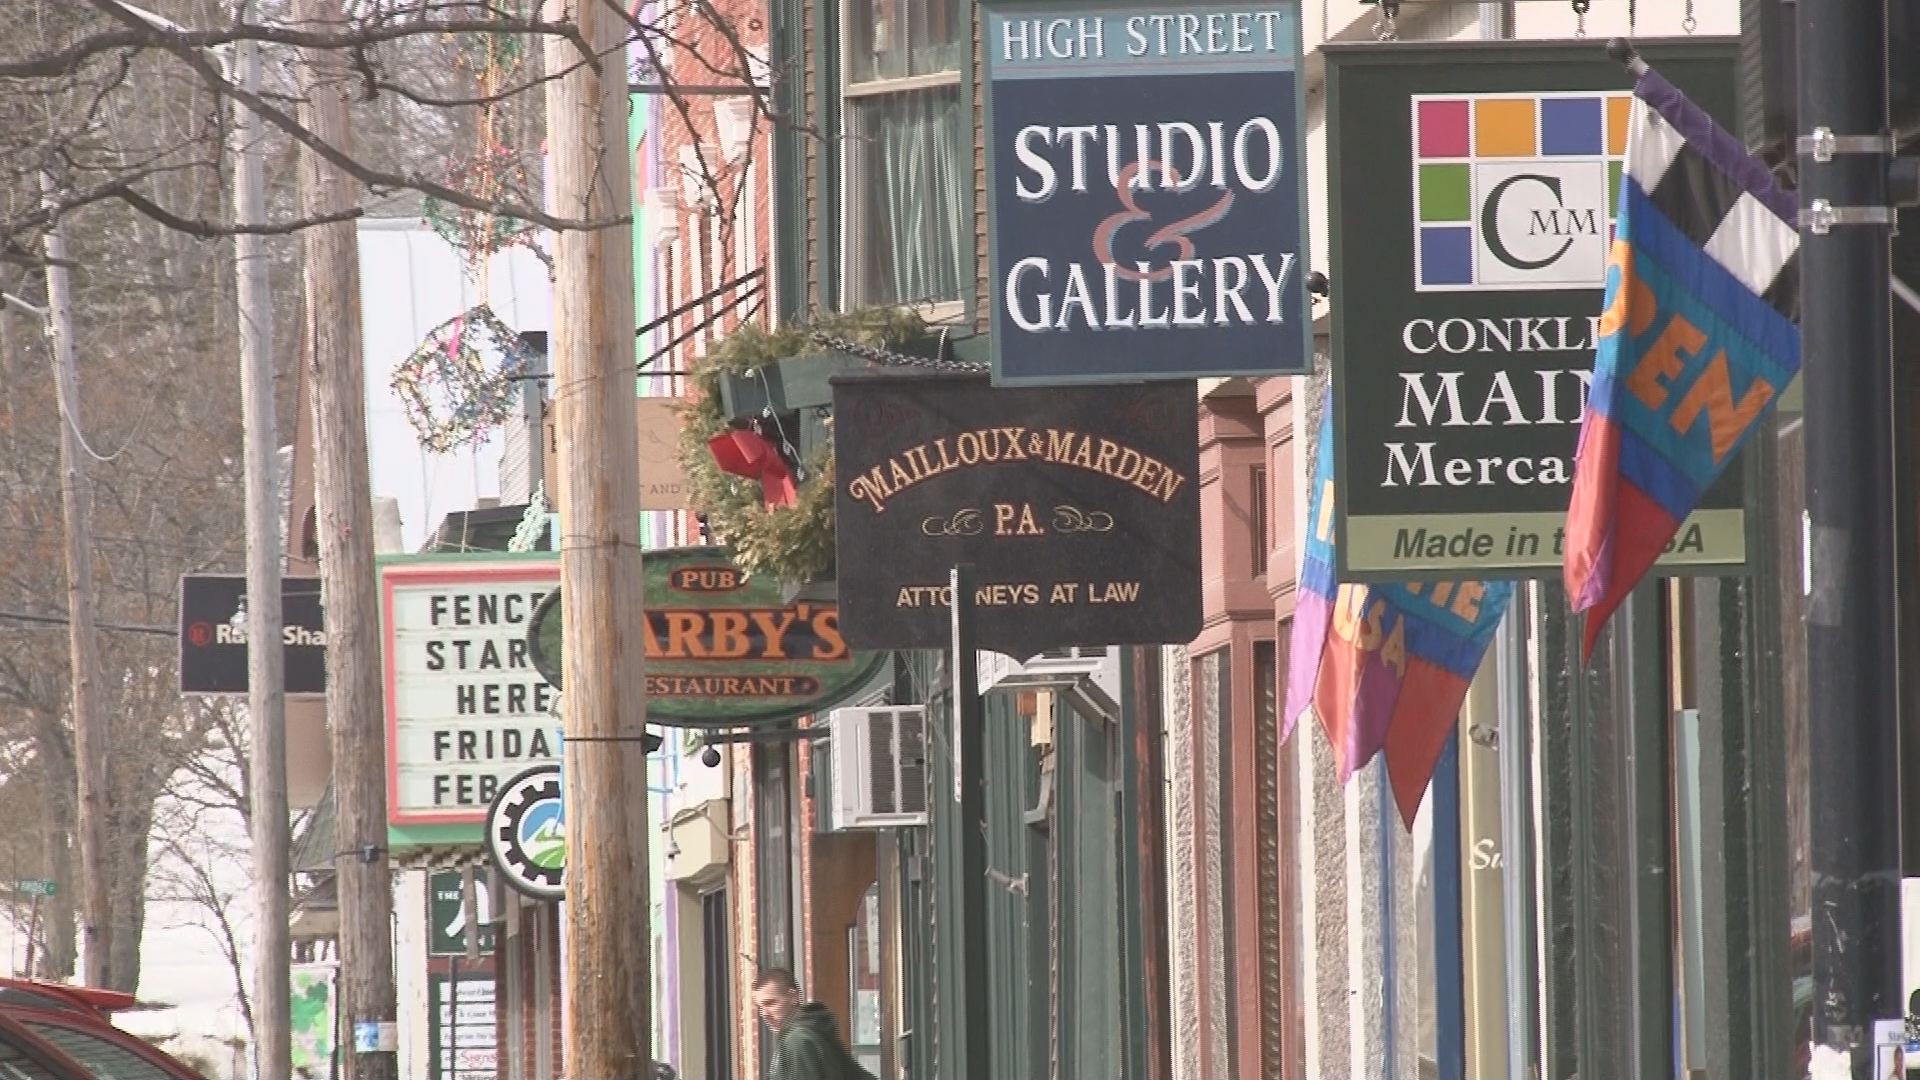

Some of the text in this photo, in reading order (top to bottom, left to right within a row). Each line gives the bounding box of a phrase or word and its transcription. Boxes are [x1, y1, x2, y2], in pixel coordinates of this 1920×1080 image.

[1002, 10, 1281, 60] HIGH STREET
[1014, 116, 1283, 201] STUDIO
[1092, 158, 1236, 283] &
[1004, 252, 1297, 334] GALLERY
[850, 427, 1027, 514] MAILLOUX
[1045, 428, 1186, 503] MARDEN
[1381, 442, 1578, 487] Merca
[650, 484, 681, 495] AND
[994, 504, 1044, 536] P.A.
[1394, 527, 1493, 559] Made
[1505, 526, 1539, 557] in
[681, 570, 736, 589] PUB
[896, 582, 1141, 608] ATTONEYS AT LAW
[426, 637, 528, 671] STAR
[457, 682, 551, 714] HERE
[433, 728, 552, 762] FRIDA
